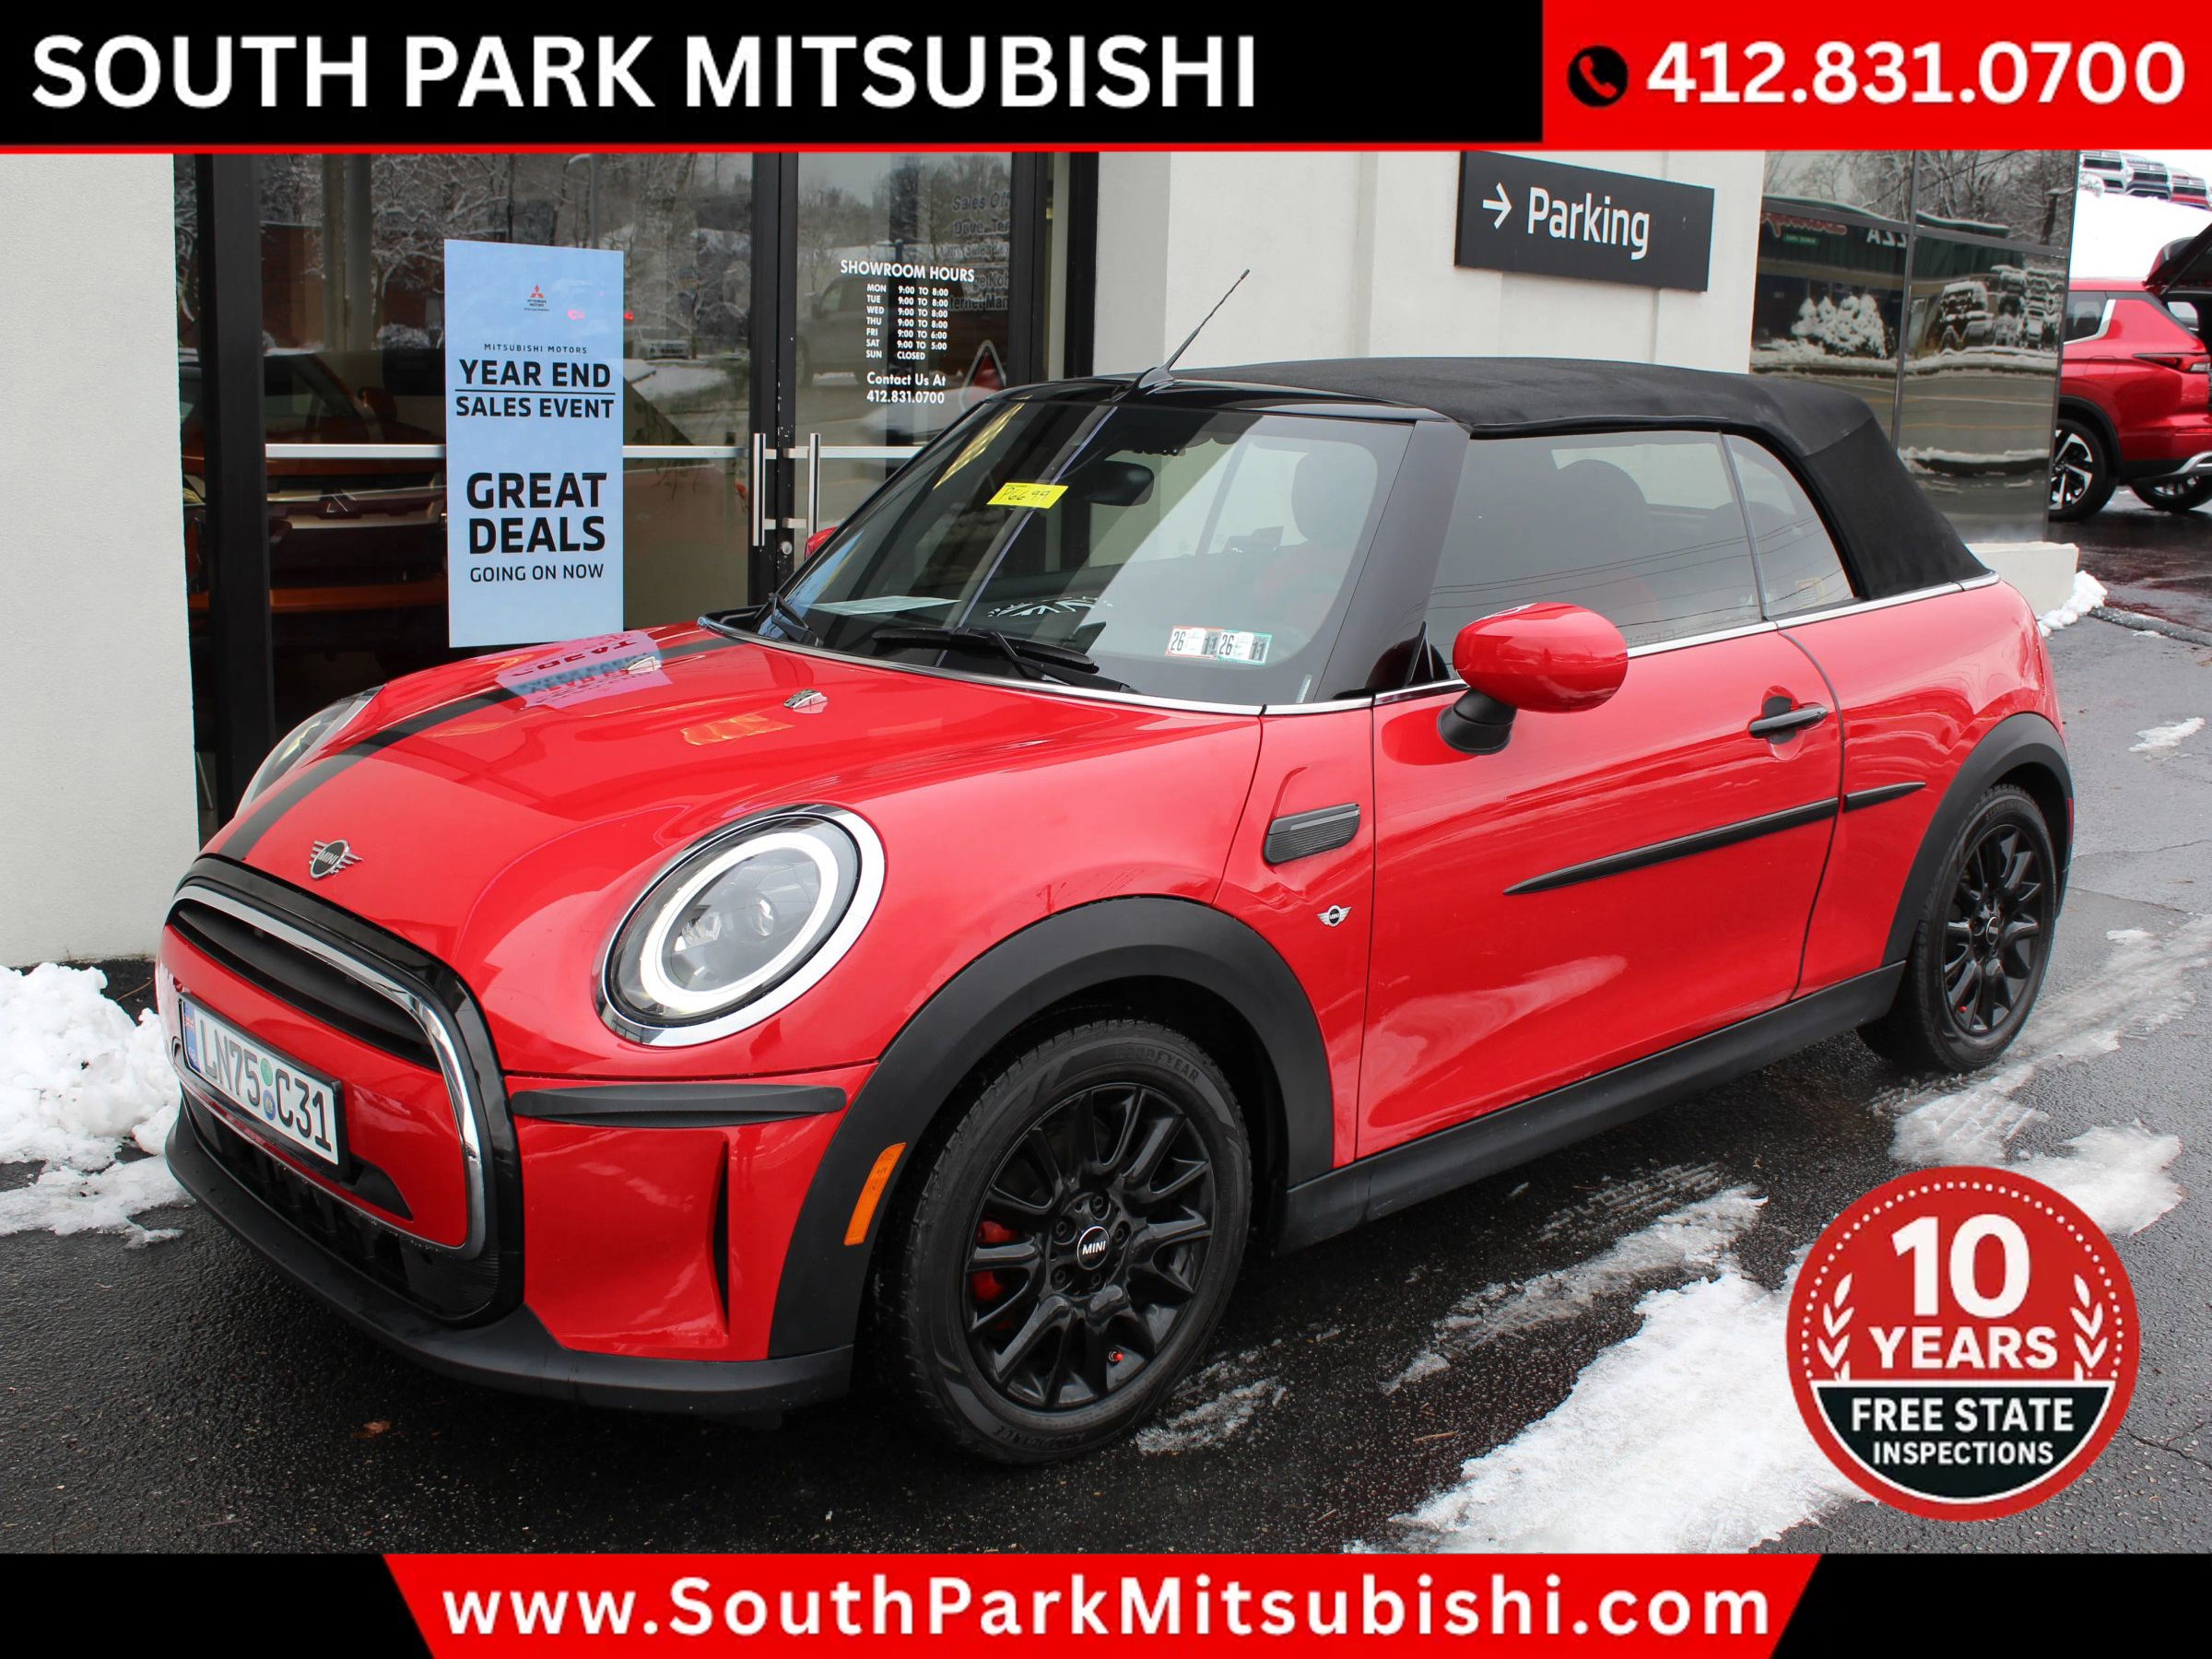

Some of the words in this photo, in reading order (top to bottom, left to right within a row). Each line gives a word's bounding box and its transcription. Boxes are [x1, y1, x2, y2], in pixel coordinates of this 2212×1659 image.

[1527, 186, 1650, 260] Parking
[840, 259, 926, 279] SHOWROOM
[929, 266, 975, 283] HOURS
[866, 283, 887, 292] MON
[898, 285, 915, 294] 9:00
[918, 287, 929, 295] TO
[932, 288, 949, 297] 8:00
[866, 294, 881, 303] TUE
[898, 296, 914, 305] 9:00
[917, 298, 928, 306] TO
[932, 299, 948, 307] 8:00
[866, 305, 885, 314] WED
[898, 307, 914, 316] 9:00
[917, 309, 928, 317] TO
[931, 309, 948, 318] 8:00
[866, 316, 882, 325] THU
[897, 318, 914, 327] 9:00
[917, 319, 928, 328] TO
[931, 320, 948, 329] 8:00
[866, 327, 878, 336] FRI
[897, 329, 914, 338] 9:00
[917, 330, 928, 338] TO
[931, 331, 947, 339] 6:00
[484, 343, 543, 352] MITSUBISHI
[547, 345, 587, 354] MOTORS
[865, 338, 880, 347] SAT
[897, 340, 913, 348] 9:00
[916, 341, 926, 349] TO
[931, 341, 947, 350] 5:00
[865, 349, 882, 359] SUN
[897, 351, 926, 360] CLOSED
[458, 359, 542, 386] YEAR
[552, 361, 611, 388] END
[866, 371, 912, 385] Contact
[914, 372, 929, 386] Us
[932, 373, 947, 386] At
[866, 390, 946, 404] 412.831.0700
[455, 395, 532, 418] SALES
[539, 397, 615, 418] EVENT
[466, 472, 607, 510] GREAT
[469, 515, 606, 555] DEALS
[470, 565, 526, 582] GOING
[532, 565, 557, 581] ON
[562, 563, 605, 580] NOW
[1171, 630, 1186, 652] 26
[1218, 634, 1234, 656] 26
[200, 1019, 261, 1106] LN75
[276, 1068, 332, 1152] C31
[1082, 1240, 1107, 1255] MINI
